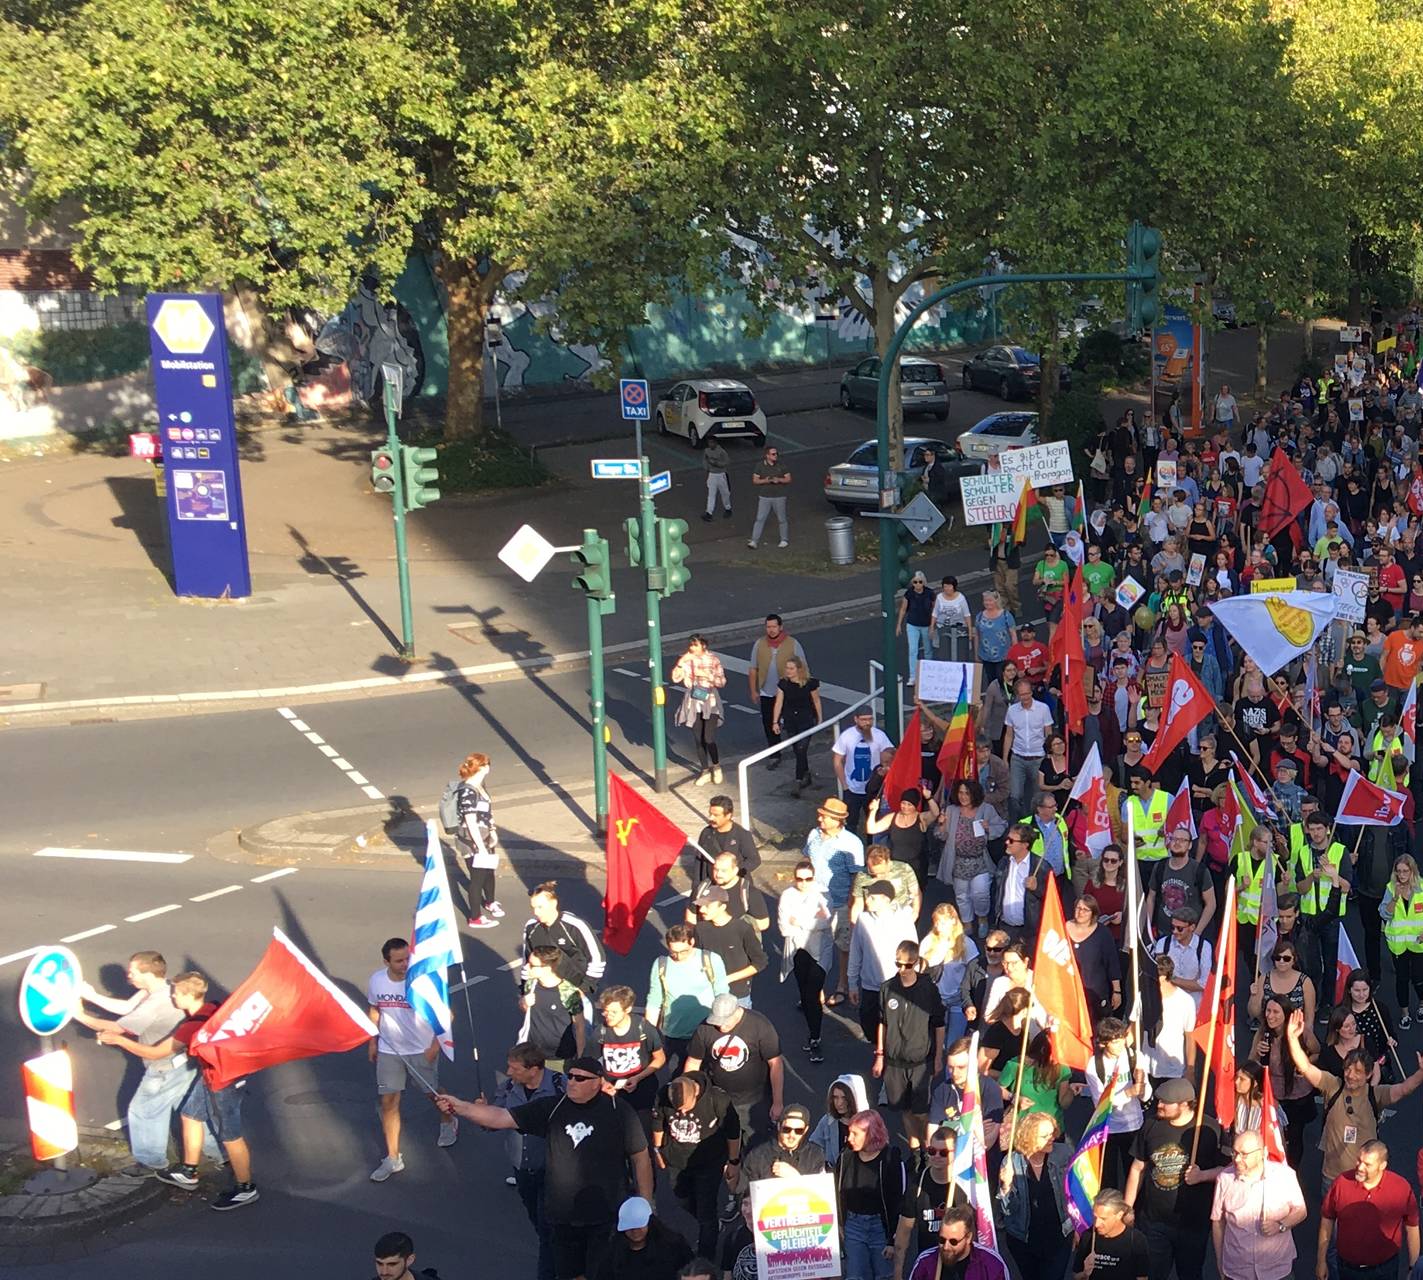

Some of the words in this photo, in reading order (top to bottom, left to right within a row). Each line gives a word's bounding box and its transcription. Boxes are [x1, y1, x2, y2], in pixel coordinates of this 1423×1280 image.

[161, 360, 215, 370] Mobilstation
[625, 406, 646, 416] TAXI
[1001, 455, 1013, 465] Es
[1020, 450, 1041, 462] gibt
[1047, 446, 1069, 456] kein
[1038, 457, 1061, 470] auf
[962, 474, 1013, 487] SCHULTER
[964, 483, 1015, 498] SCHULTER
[965, 495, 996, 507] GEGEN
[1243, 707, 1267, 717] NAZIS
[603, 1046, 640, 1063] FCK
[781, 1235, 818, 1250] BLEIBEN
